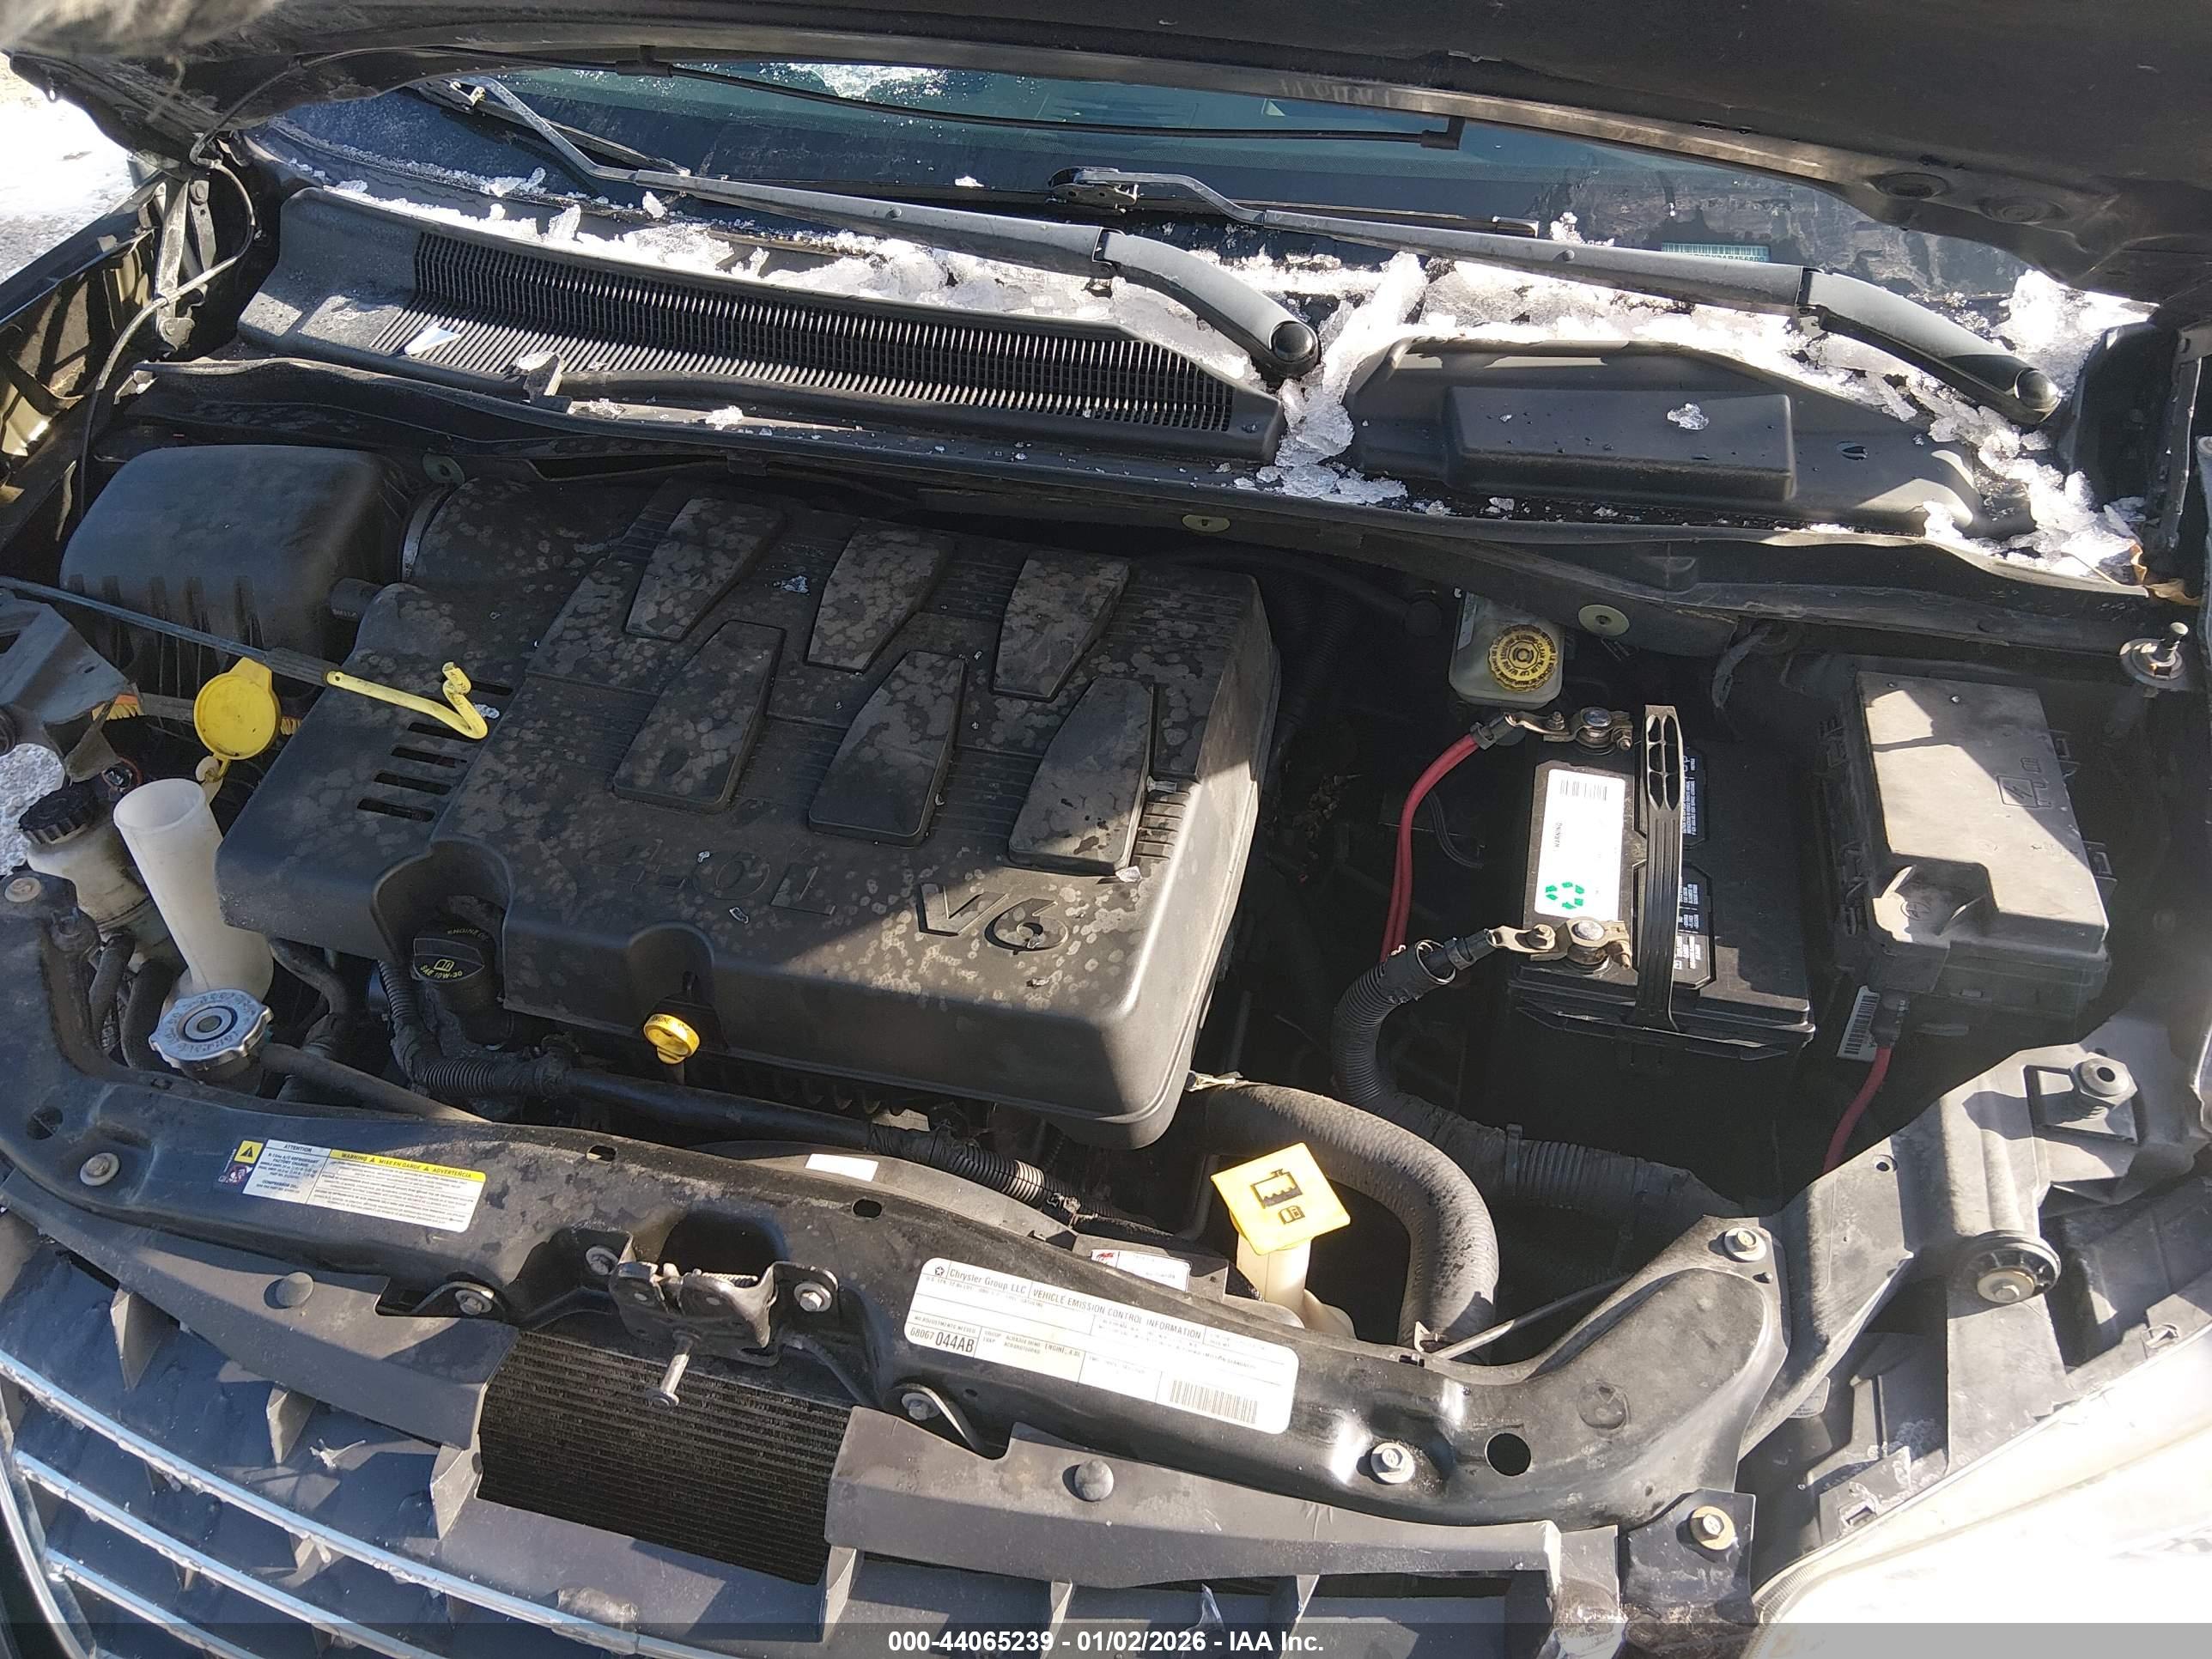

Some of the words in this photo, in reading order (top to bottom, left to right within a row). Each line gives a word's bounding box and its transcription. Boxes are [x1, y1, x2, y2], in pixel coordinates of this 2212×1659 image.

[1553, 822, 1563, 848] WARNING
[916, 881, 1071, 954] V6
[447, 927, 479, 936] ENGINE
[420, 964, 434, 976] SAE
[434, 970, 463, 979] 10W-30
[283, 1144, 313, 1152] ATTENTION
[342, 1152, 368, 1162] WARNING
[950, 1268, 982, 1283] Chrysler
[984, 1277, 1009, 1291] Group
[1011, 1283, 1027, 1294] LLC
[1033, 1288, 1066, 1304] VEHICLE
[1067, 1297, 1105, 1316] EMISSION
[1108, 1307, 1143, 1324] CONTROL
[1146, 1318, 1202, 1340] INFORMATION
[910, 1327, 935, 1340] 68067
[935, 1331, 975, 1353] 044AB
